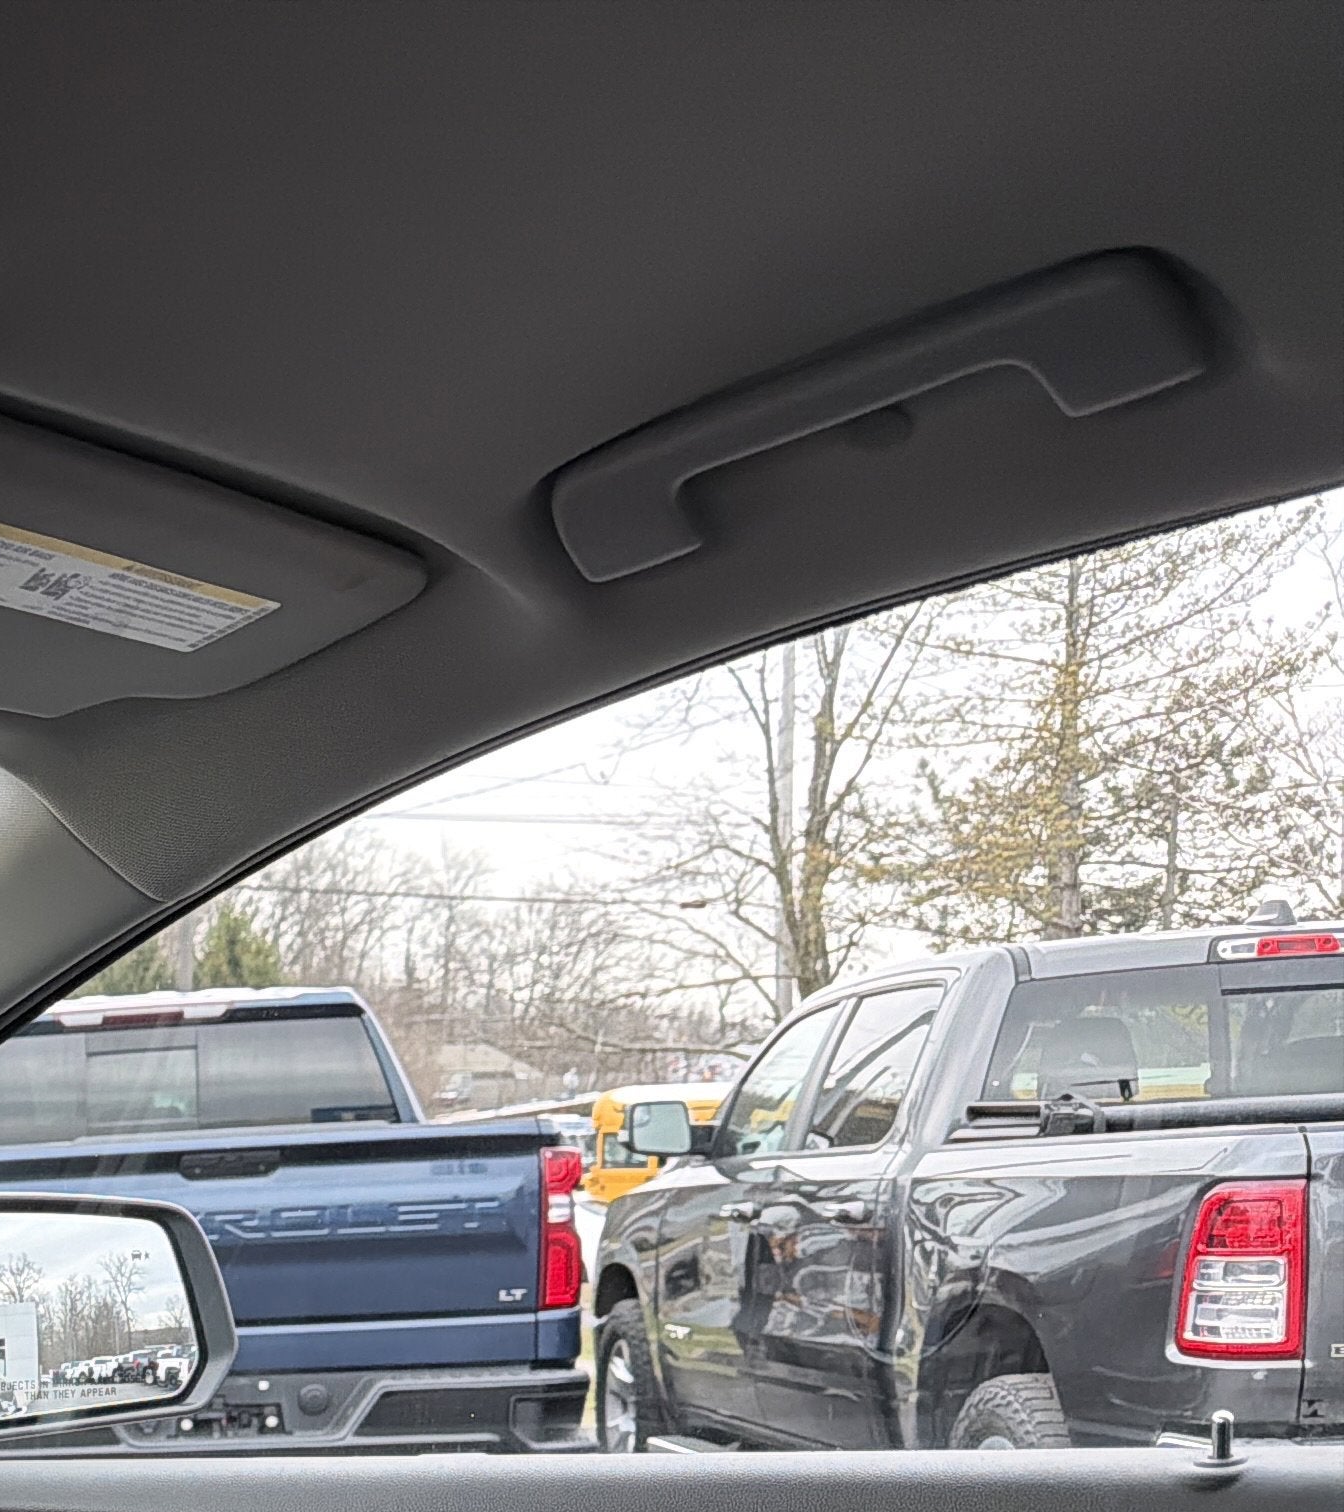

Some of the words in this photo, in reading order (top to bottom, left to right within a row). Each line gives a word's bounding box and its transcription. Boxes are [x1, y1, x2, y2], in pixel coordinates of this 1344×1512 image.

[498, 1287, 529, 1302] LT
[24, 1390, 49, 1401] THAN
[53, 1388, 76, 1399] THEY
[80, 1386, 117, 1398] APPEAR
